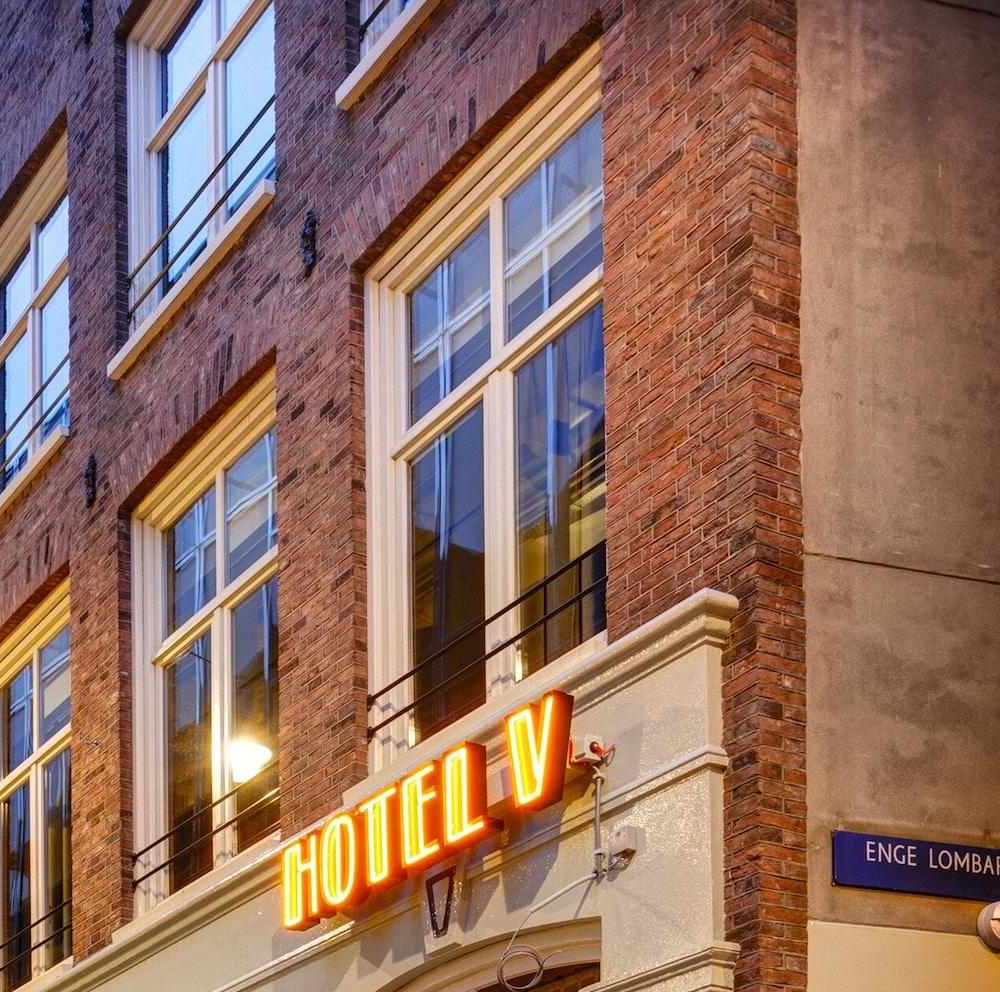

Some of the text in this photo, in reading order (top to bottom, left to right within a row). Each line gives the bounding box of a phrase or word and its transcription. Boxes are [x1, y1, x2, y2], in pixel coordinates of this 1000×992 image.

[282, 692, 560, 929] HOTEL V
[865, 840, 917, 867] ENGE
